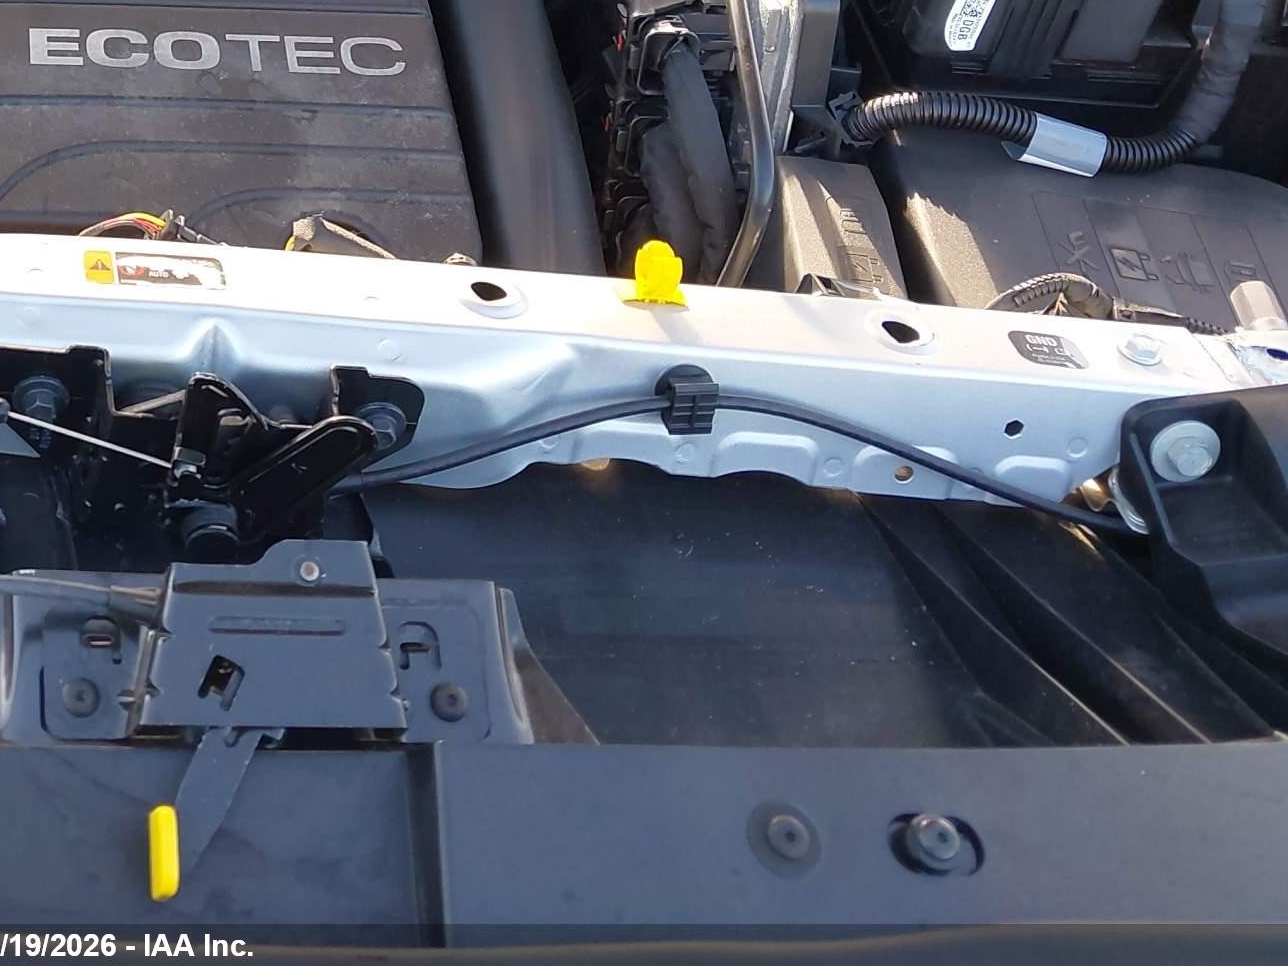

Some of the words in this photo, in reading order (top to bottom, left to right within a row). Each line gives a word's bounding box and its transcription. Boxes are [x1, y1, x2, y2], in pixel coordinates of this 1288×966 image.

[957, 19, 975, 40] DGB
[28, 27, 405, 79] ECOTEC
[1025, 334, 1057, 347] GND
